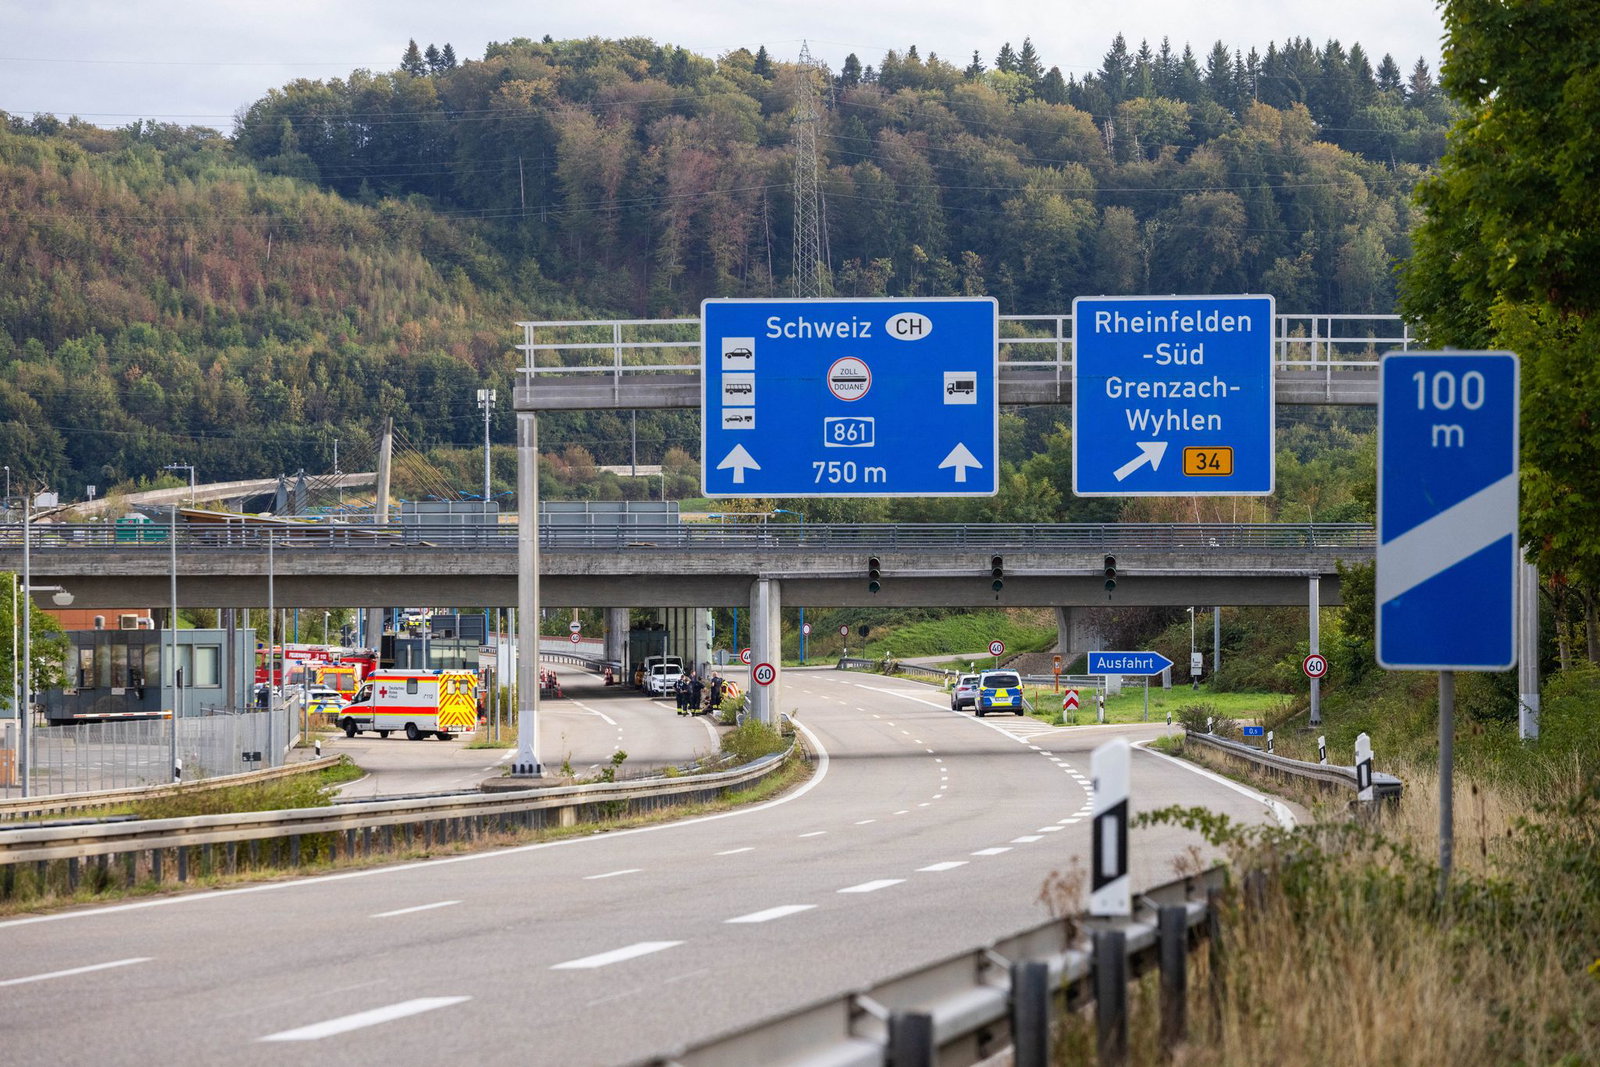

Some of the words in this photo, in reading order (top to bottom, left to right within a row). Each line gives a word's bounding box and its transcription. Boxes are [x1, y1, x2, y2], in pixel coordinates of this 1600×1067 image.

[766, 316, 872, 339] Schweiz
[896, 318, 923, 336] CH
[1095, 310, 1251, 333] Rheinfelden
[1143, 342, 1204, 366] -Süd
[840, 368, 858, 376] ZOLL
[834, 383, 865, 392] DOUANE
[1106, 376, 1240, 399] Grenzach-
[1412, 370, 1485, 411] 100
[834, 423, 865, 441] 861
[1126, 408, 1222, 437] Wyhlen
[1432, 424, 1464, 448] m
[1196, 452, 1221, 471] 34
[812, 461, 857, 484] 750
[864, 465, 887, 484] m
[992, 644, 1002, 652] 40
[1097, 656, 1154, 670] Ausfahrt
[1308, 660, 1323, 672] 60
[758, 668, 771, 680] 60
